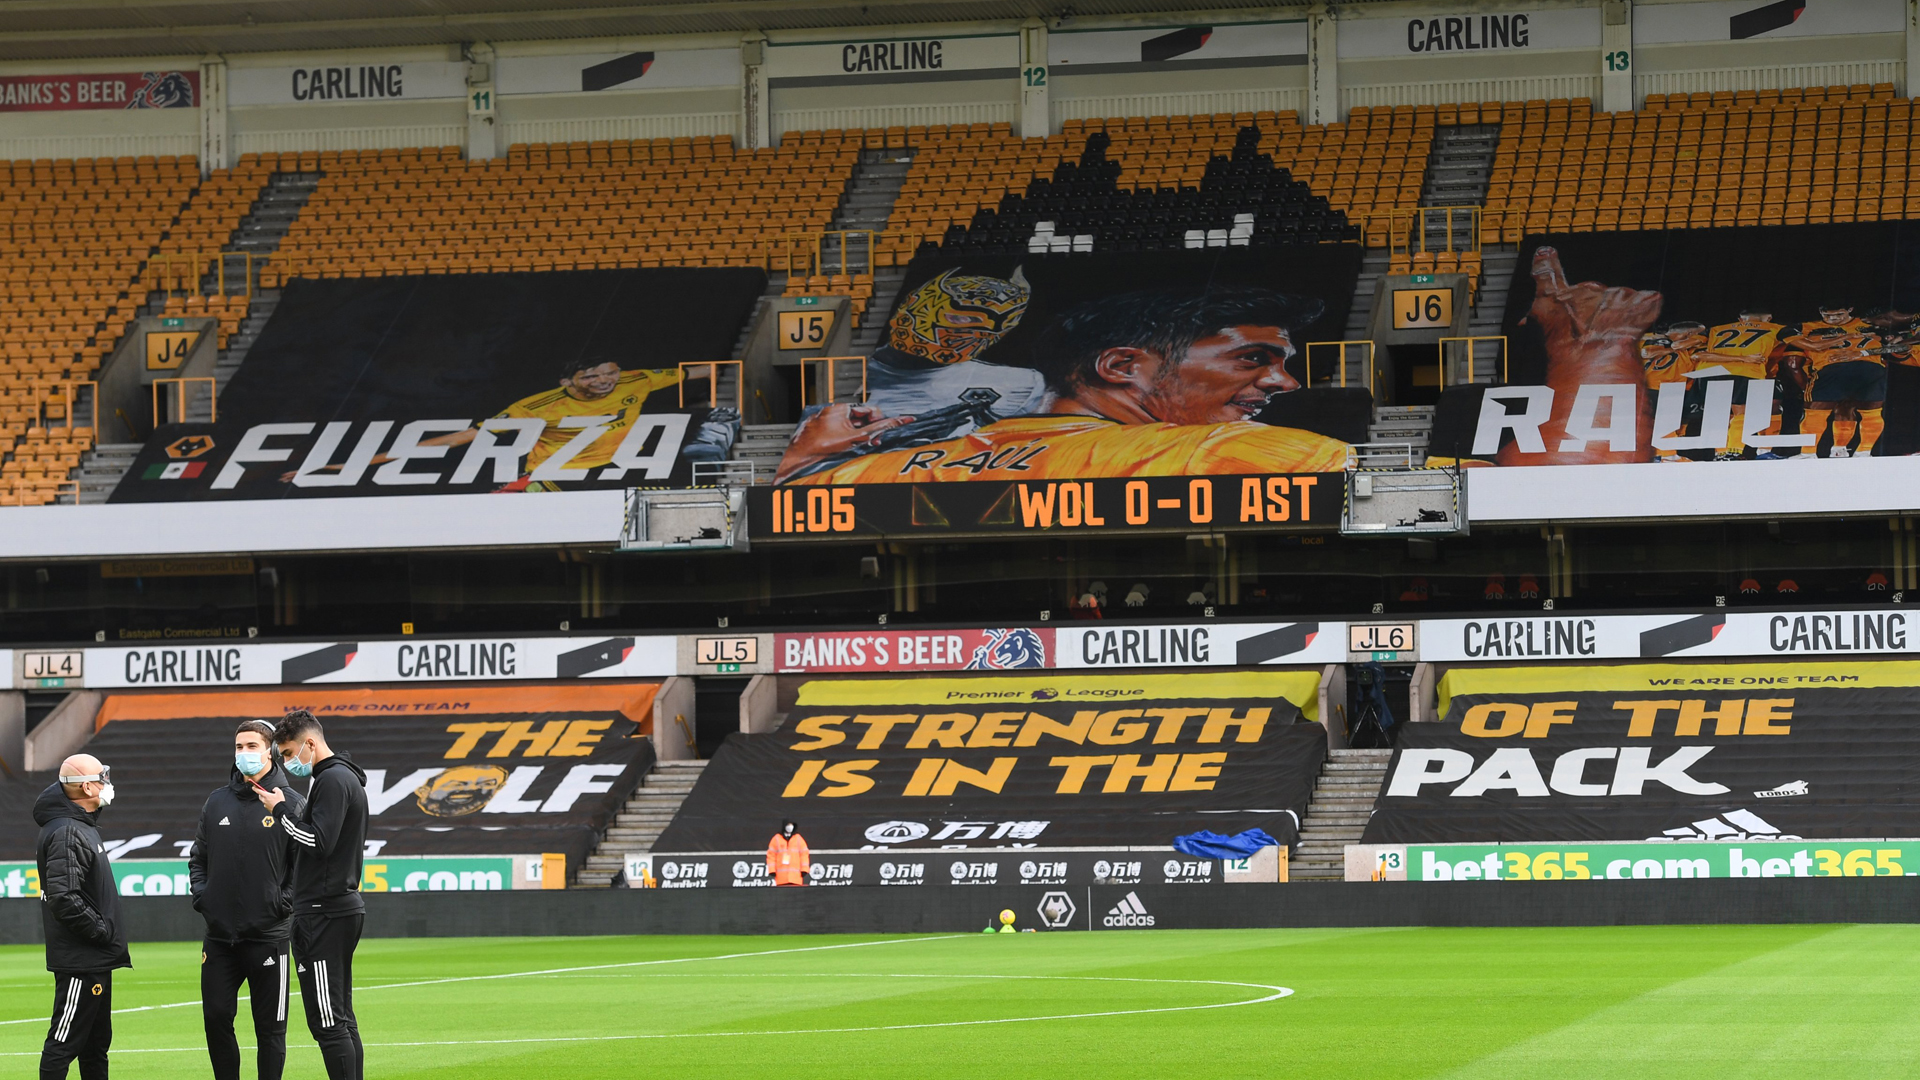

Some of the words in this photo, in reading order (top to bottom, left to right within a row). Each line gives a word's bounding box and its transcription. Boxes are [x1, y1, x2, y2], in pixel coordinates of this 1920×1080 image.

[1407, 14, 1529, 53] CARLING
[842, 41, 942, 73] CARLING
[1606, 51, 1629, 71] 13
[292, 65, 402, 101] CARLING
[1023, 67, 1046, 86] 12
[78, 81, 126, 103] BEER
[472, 92, 489, 110] 11
[1406, 294, 1442, 322] J6
[791, 317, 824, 343] J5
[1714, 328, 1772, 349] 27
[158, 338, 188, 363] J4
[210, 413, 691, 489] FUERZA
[772, 486, 855, 533] 11:05
[1018, 482, 1104, 528] WOL
[1126, 478, 1212, 525] 0-0
[1240, 476, 1318, 523] AST
[1301, 535, 1324, 545] local
[112, 561, 160, 575] Eastgate
[163, 559, 229, 573] Commercial
[232, 558, 249, 570] Ltd
[119, 628, 161, 639] Eastgate
[164, 627, 221, 637] Commercial
[224, 626, 240, 637] Ltd
[1360, 627, 1404, 649] JL6
[1464, 618, 1595, 658] CARLING
[1769, 613, 1906, 652] CARLING
[706, 640, 748, 662] JL5
[898, 635, 963, 665] BEER
[1082, 627, 1209, 664] CARLING
[34, 656, 73, 676] JL4
[125, 649, 241, 683] CARLING
[397, 642, 515, 677] CARLING
[1648, 678, 1685, 687] WE
[1688, 677, 1736, 686] ARE
[1740, 676, 1789, 685] ONE
[1793, 675, 1860, 684] TEAM
[946, 690, 1025, 700] Premier
[1066, 688, 1145, 699] League
[283, 705, 316, 713] WE
[319, 704, 361, 712] ARE
[364, 703, 408, 712] ONE
[412, 702, 471, 711] TEAM
[1460, 700, 1579, 738] OF
[1613, 698, 1795, 738] THE
[444, 719, 614, 759] THE
[789, 706, 1273, 753] STRENGTH
[782, 759, 879, 798] IS
[902, 757, 1018, 797] IN
[1049, 751, 1228, 794] THE
[1386, 745, 1732, 798] PACK
[1760, 788, 1797, 798] LOBOS
[930, 820, 1051, 840] 万博
[531, 863, 544, 878] 1
[629, 861, 648, 877] 12
[680, 862, 709, 878] 万博
[826, 864, 854, 879] 万博
[896, 863, 925, 878] 万博
[968, 862, 998, 878] 万博
[1037, 861, 1068, 878] 万博
[1112, 861, 1142, 877] 万博
[1182, 861, 1212, 877] 万博
[1228, 858, 1249, 870] 12
[1378, 853, 1399, 869] 13
[1422, 849, 1711, 881] bet365.com
[1103, 910, 1155, 927] adidas
